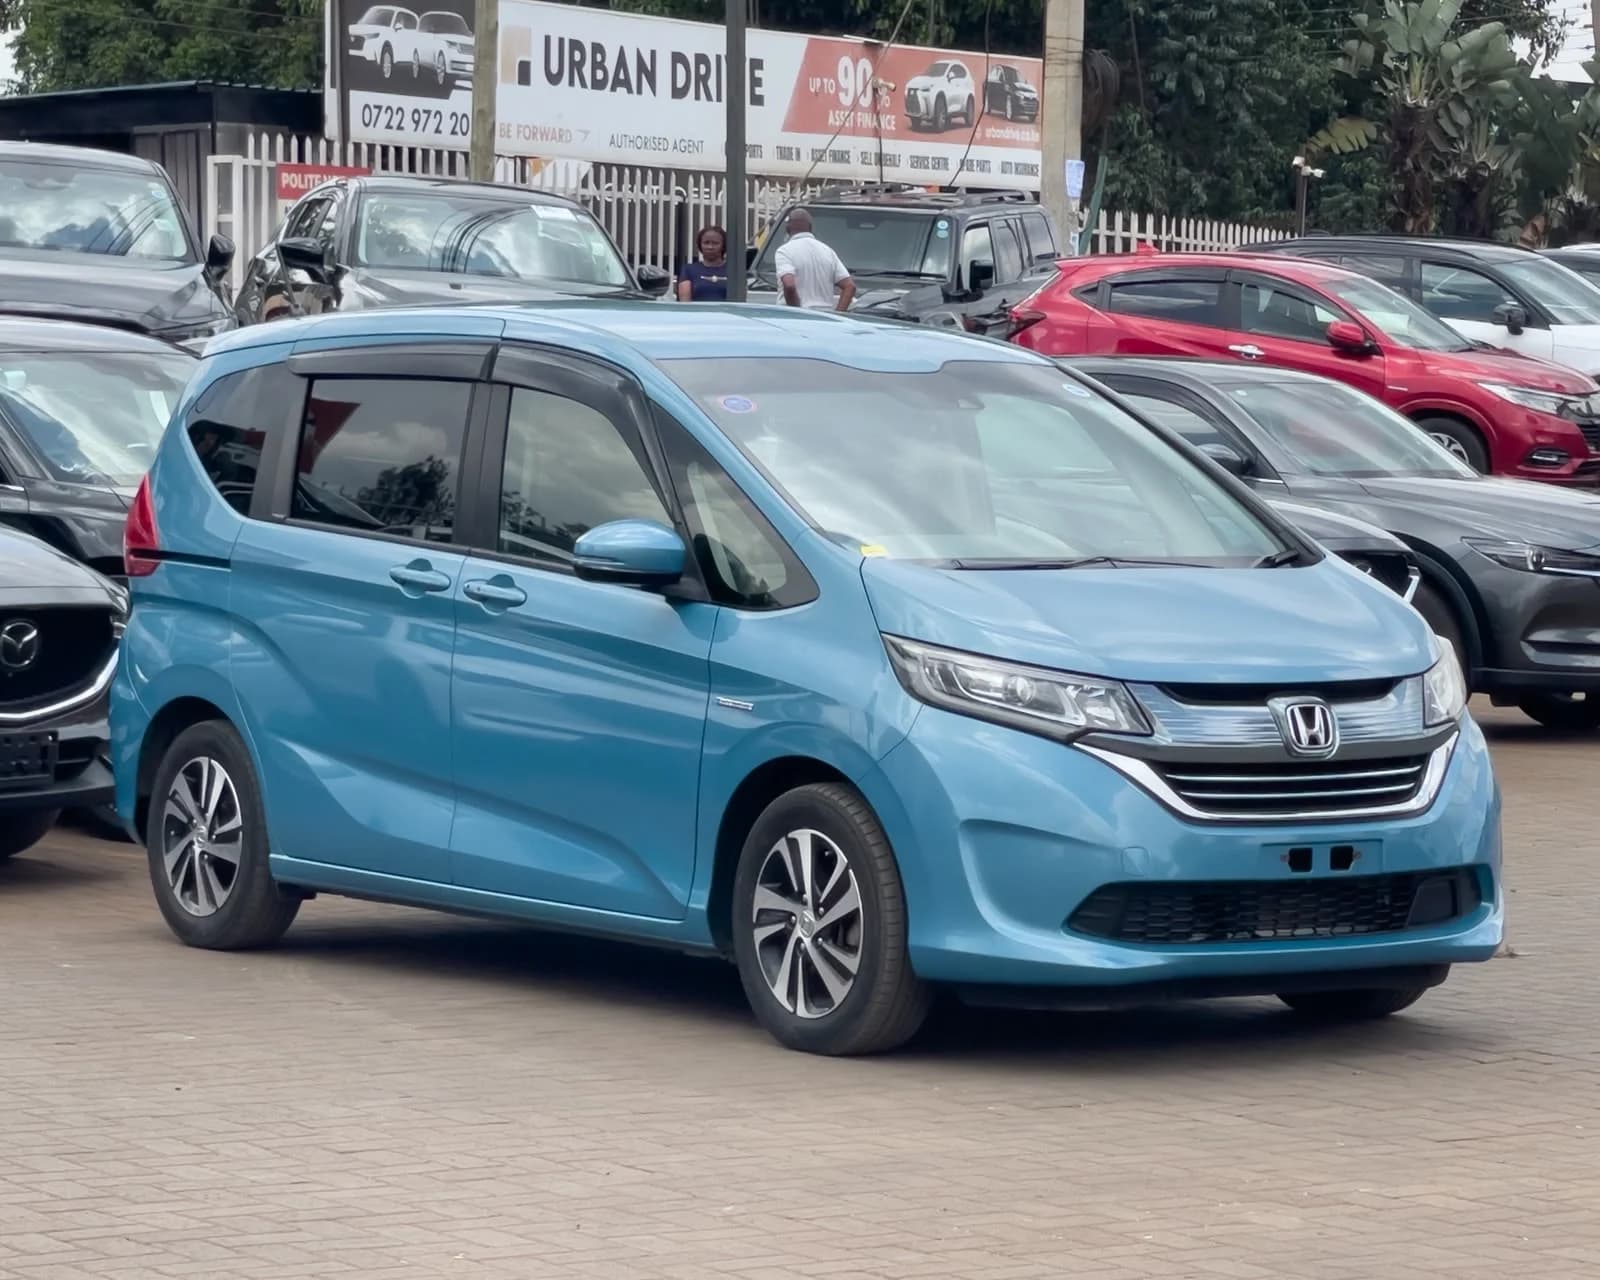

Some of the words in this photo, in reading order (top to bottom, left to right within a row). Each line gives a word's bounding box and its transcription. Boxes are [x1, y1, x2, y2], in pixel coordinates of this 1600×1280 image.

[544, 34, 656, 98] URBAN
[671, 51, 764, 106] DRIE
[809, 77, 821, 92] UP
[824, 78, 836, 94] TO
[362, 103, 405, 131] 0722
[411, 108, 442, 133] 972
[449, 111, 470, 136] 20
[828, 110, 853, 127] ASSET
[857, 112, 896, 130] FINANCE
[499, 122, 513, 138] BE
[517, 124, 572, 143] FORWARD
[609, 133, 669, 152] AUTHORISED
[672, 138, 704, 154] AGENT
[281, 172, 321, 189] POLITE
